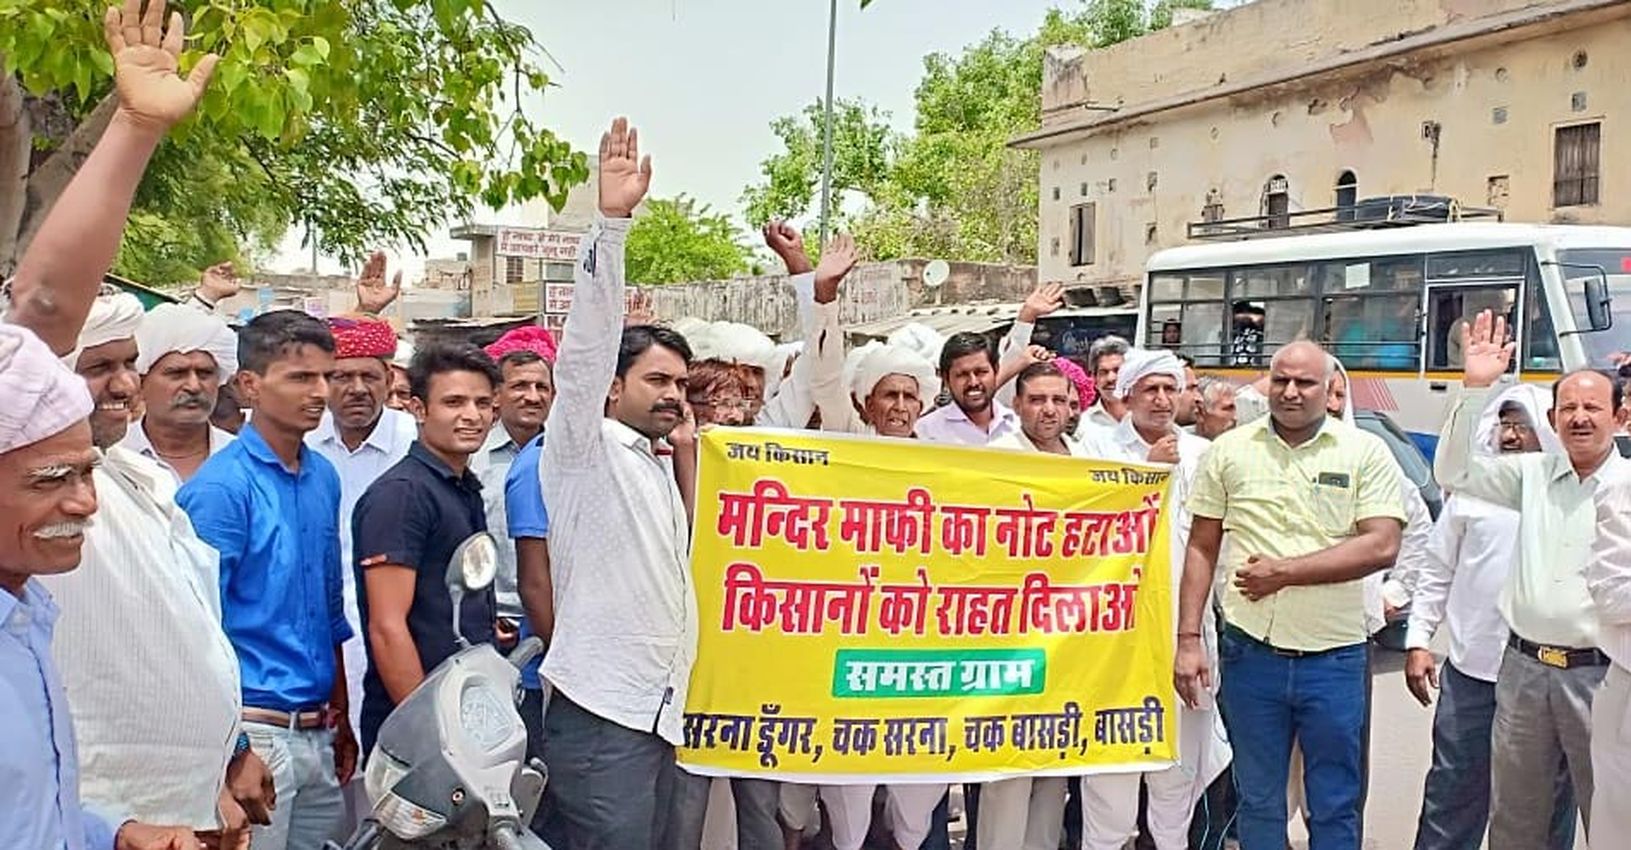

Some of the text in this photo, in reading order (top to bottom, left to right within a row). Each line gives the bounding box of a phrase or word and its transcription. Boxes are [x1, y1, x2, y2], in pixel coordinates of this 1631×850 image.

[727, 442, 829, 467] जय किसान
[1089, 469, 1120, 484] जय
[718, 480, 835, 550] मन्दिर
[839, 489, 936, 555] माफी
[941, 505, 991, 556] का
[996, 494, 1058, 558] नोट
[722, 564, 879, 635] किसानों
[879, 570, 931, 636] को
[936, 584, 1018, 637] राहत
[846, 658, 1033, 691] समस्त ग्राम
[683, 712, 756, 751] सरना
[832, 715, 878, 755] चक
[883, 713, 956, 761] सरना,
[963, 711, 1007, 754] चक
